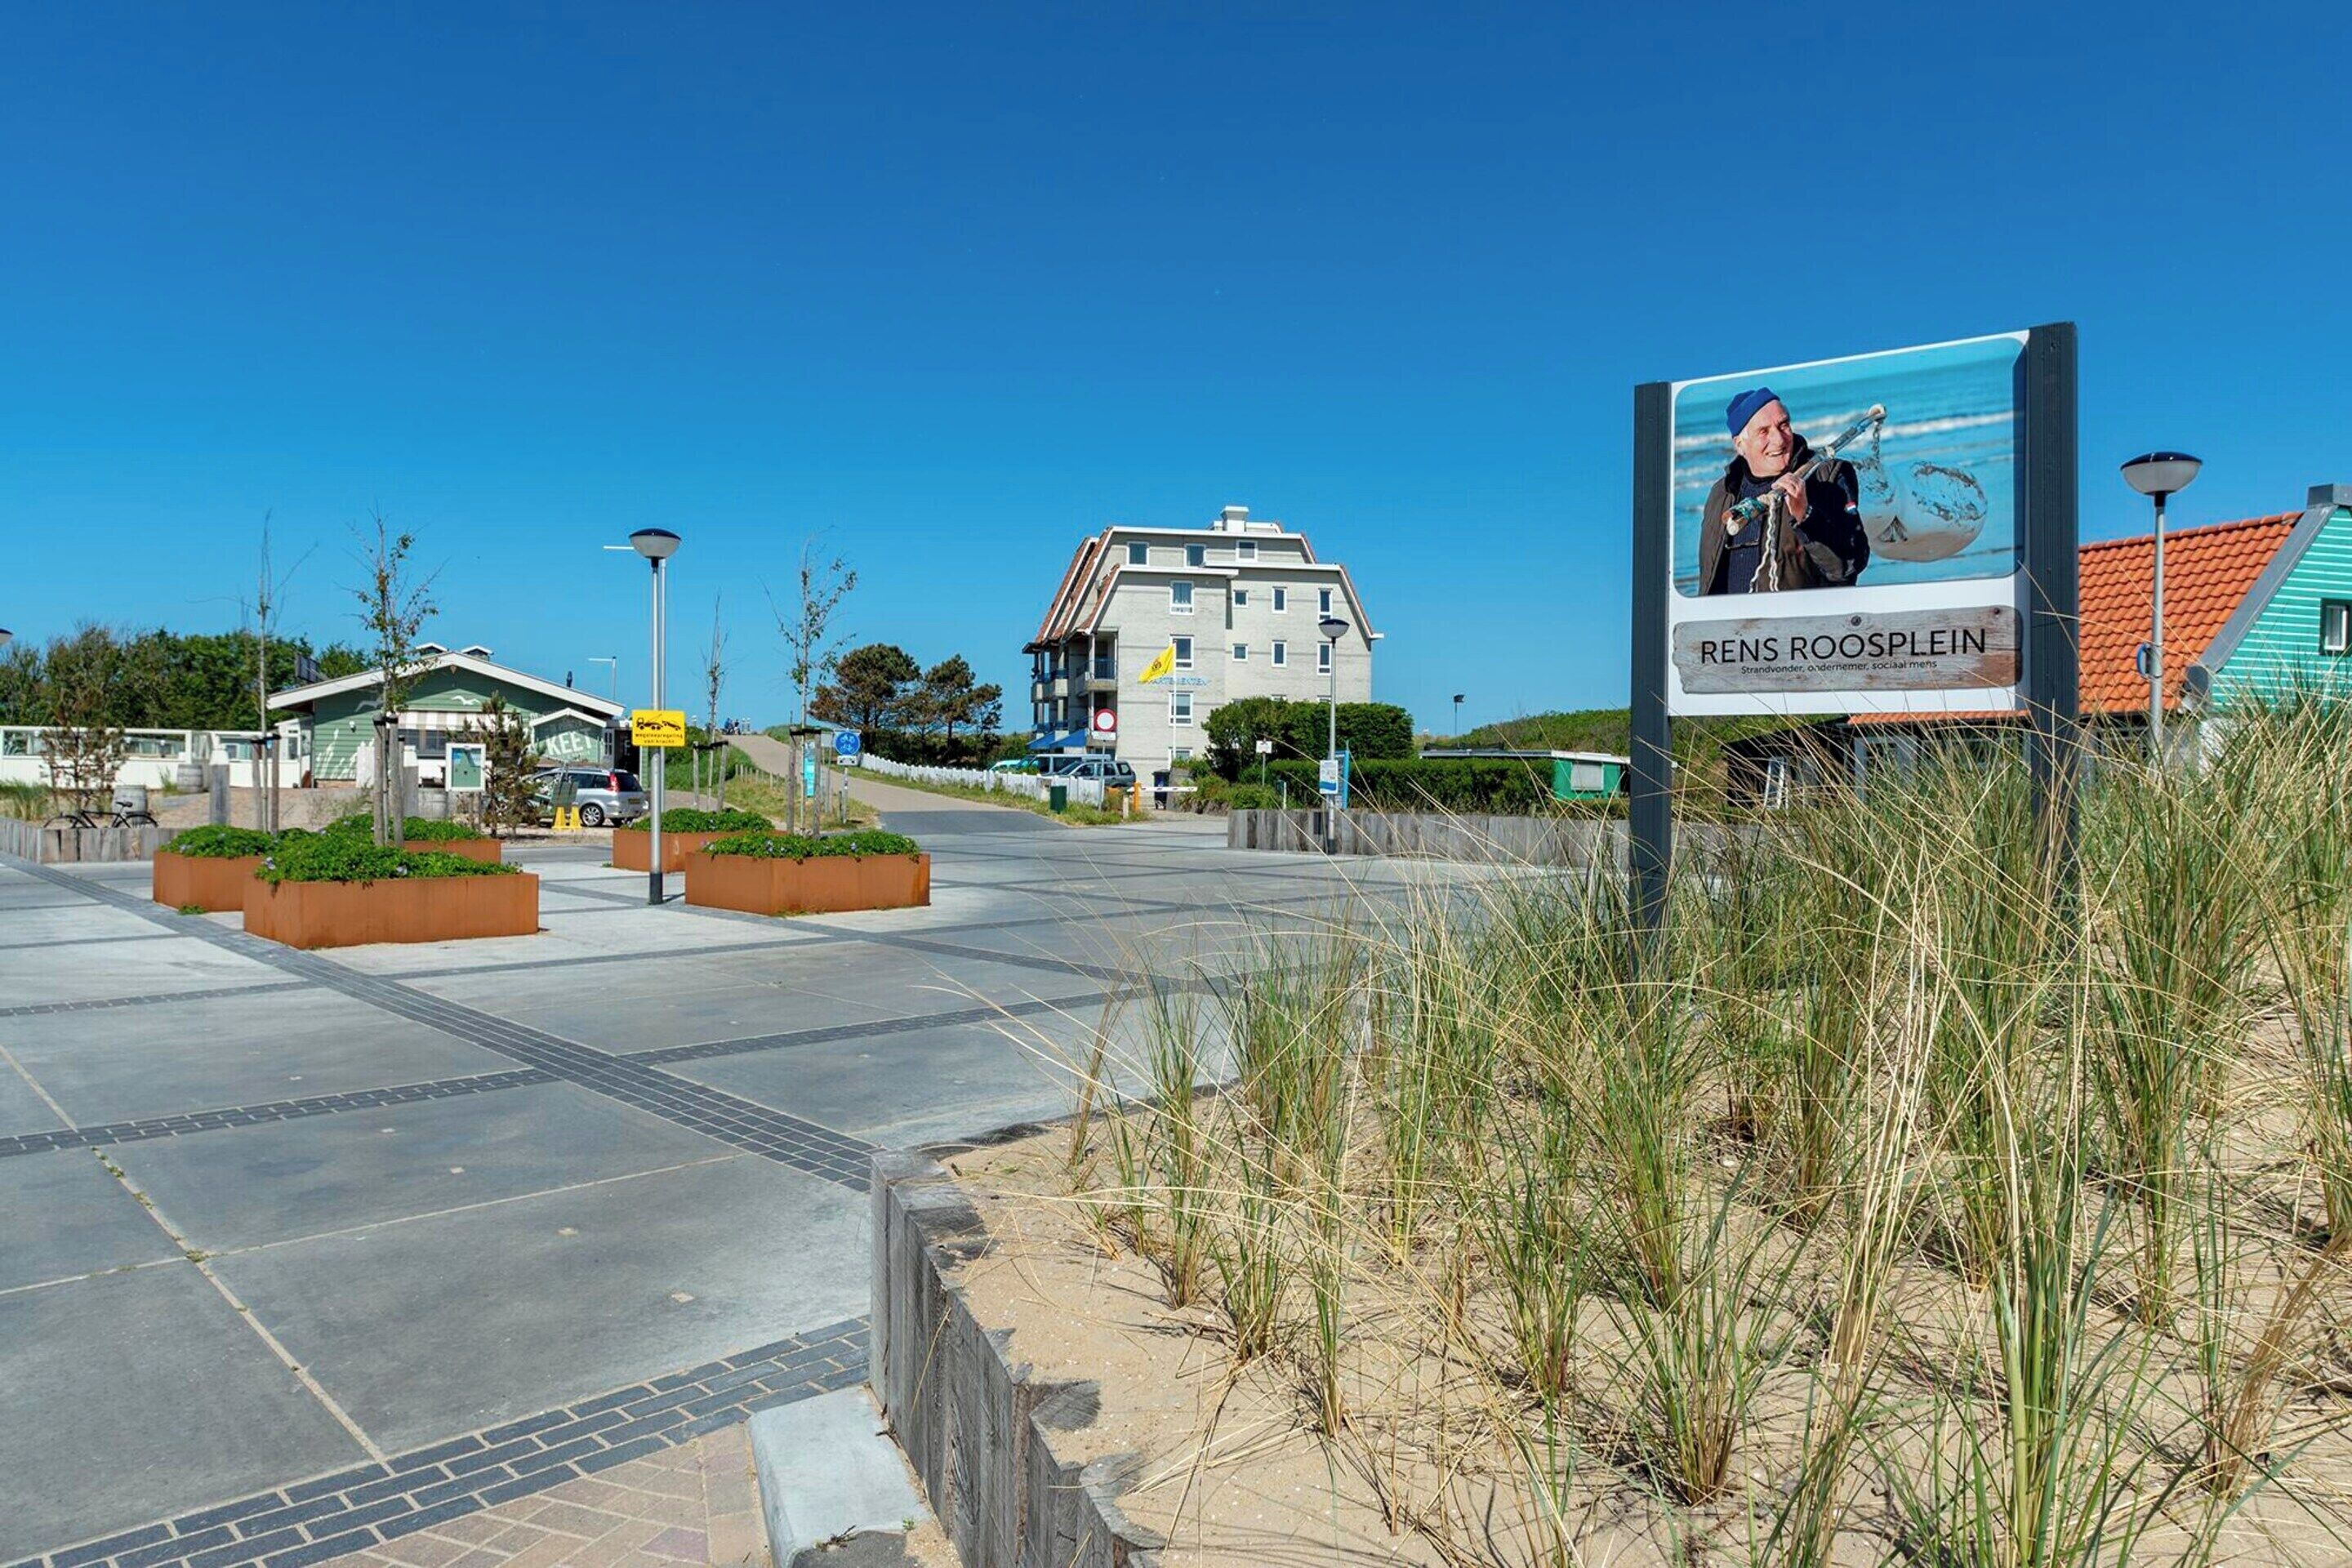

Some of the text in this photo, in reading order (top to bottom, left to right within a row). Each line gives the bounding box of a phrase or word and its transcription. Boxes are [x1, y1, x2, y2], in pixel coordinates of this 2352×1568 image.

[1701, 628, 1985, 664] RENS ROOSPLEIN
[1872, 660, 1907, 670] sociaal
[1909, 660, 1938, 669] mens
[546, 727, 592, 755] KEET
